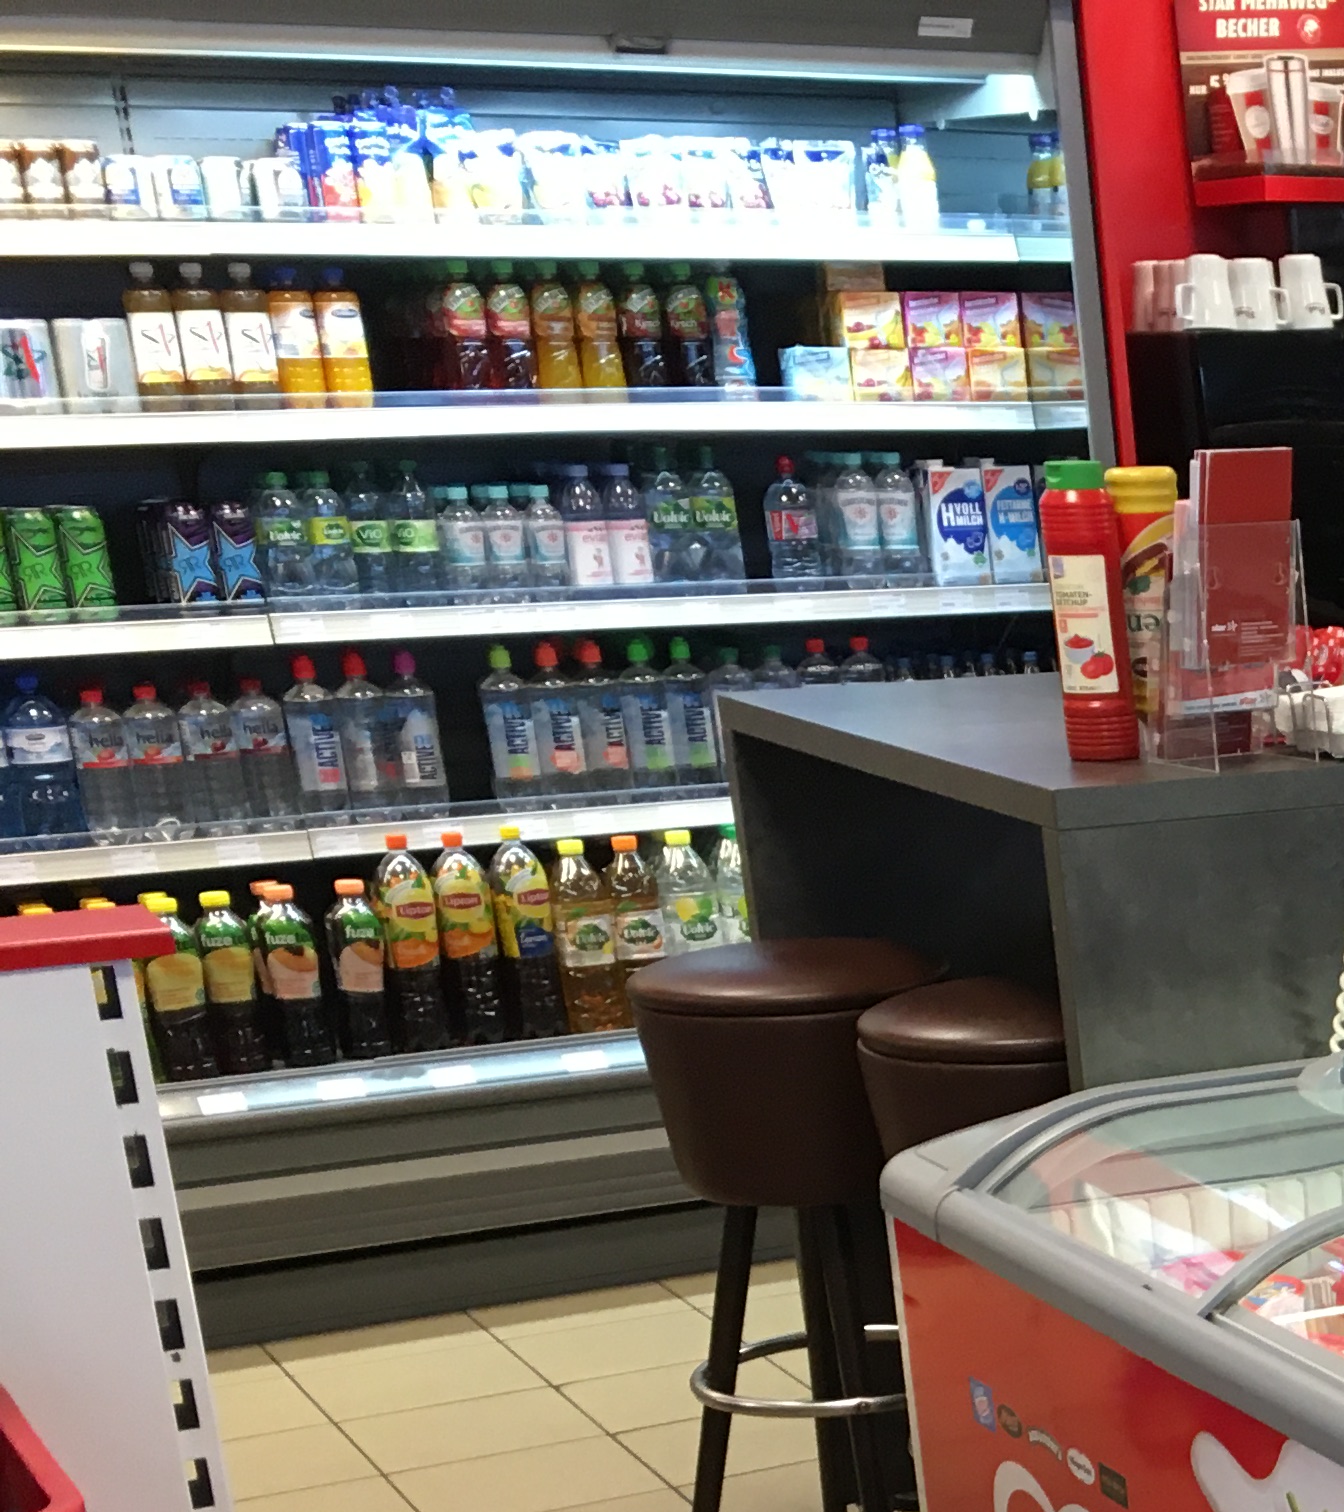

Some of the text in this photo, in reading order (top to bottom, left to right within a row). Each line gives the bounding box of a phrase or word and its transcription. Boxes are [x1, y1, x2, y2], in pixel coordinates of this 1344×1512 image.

[1216, 17, 1280, 38] BECHER
[955, 502, 981, 514] VOLL
[955, 514, 983, 526] MILCH
[1055, 590, 1093, 599] TOMATEN-
[201, 725, 232, 739] hella
[243, 720, 279, 735] hella
[89, 732, 123, 747] hella
[136, 730, 173, 745] hella
[201, 933, 233, 948] fuze
[265, 931, 296, 945] fuze
